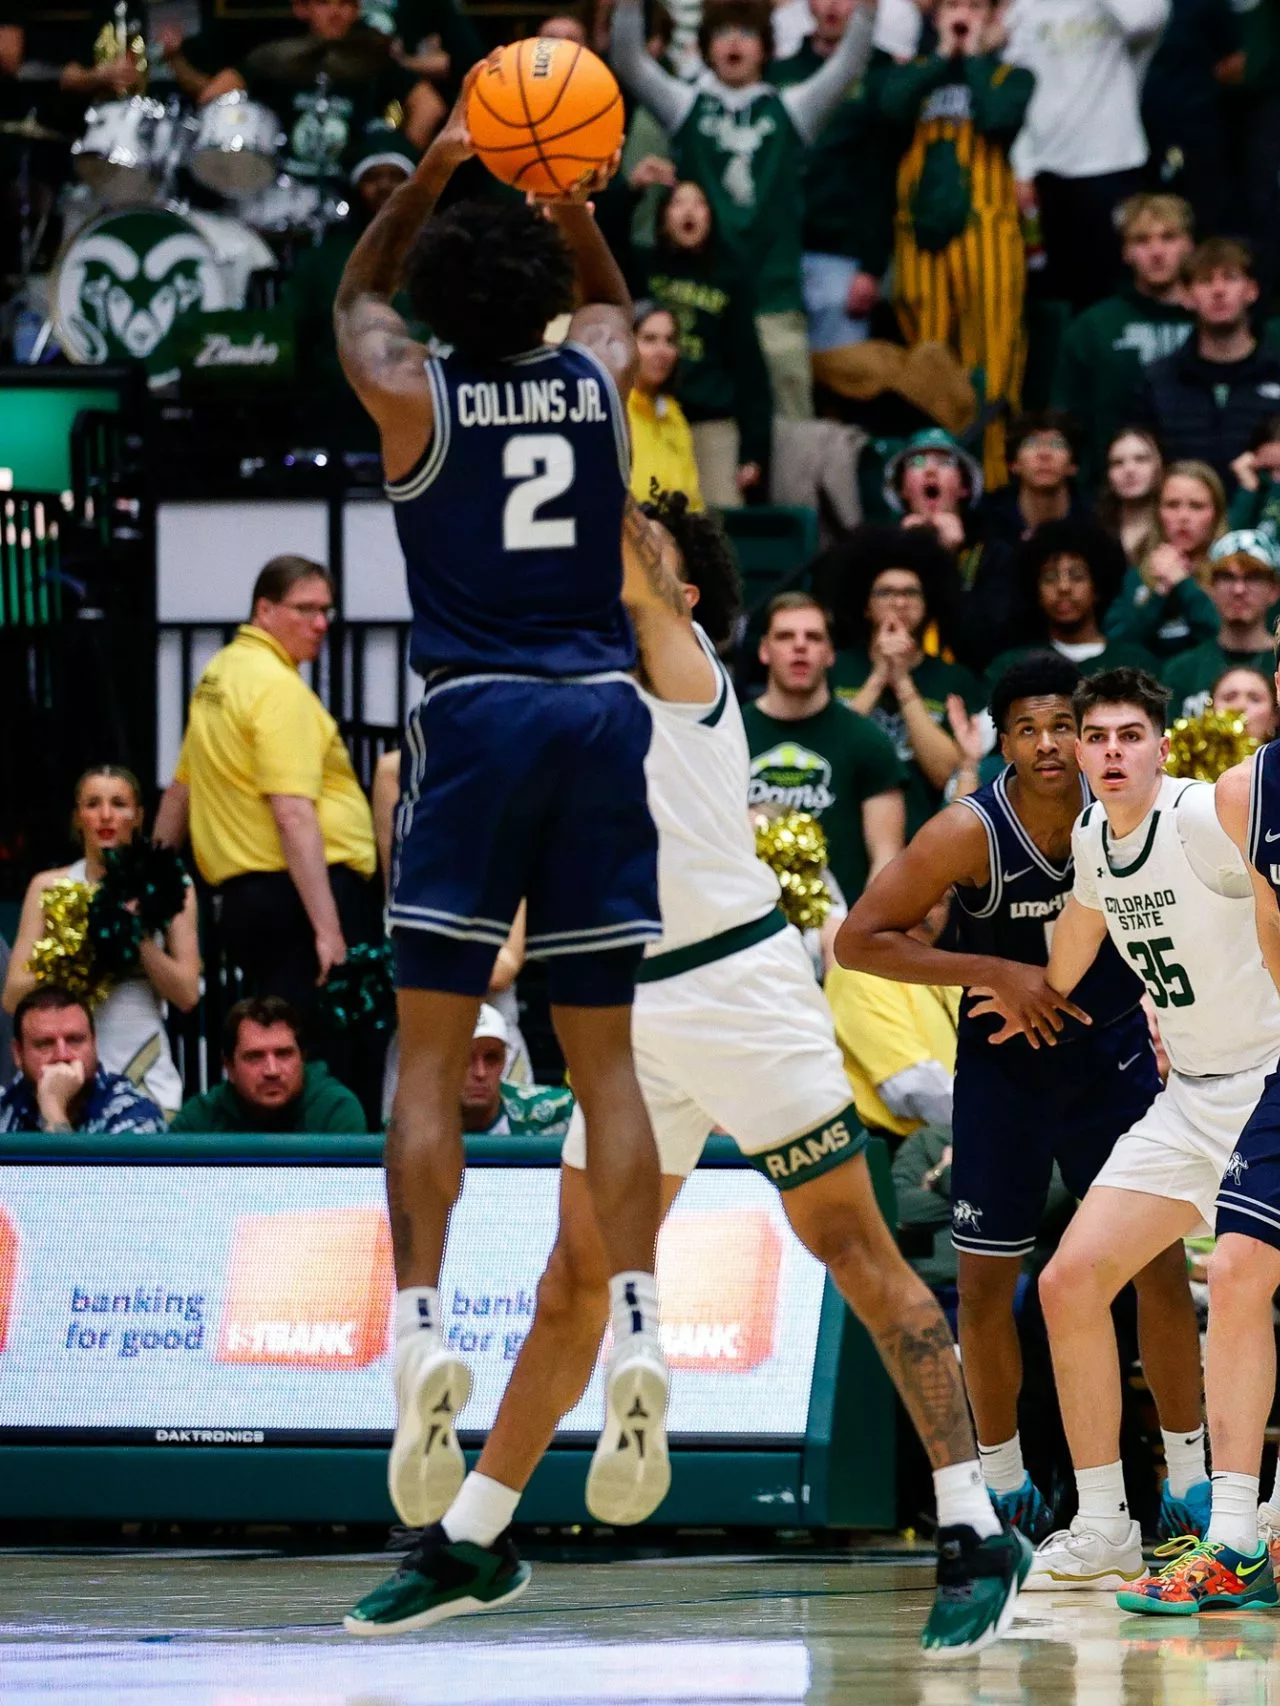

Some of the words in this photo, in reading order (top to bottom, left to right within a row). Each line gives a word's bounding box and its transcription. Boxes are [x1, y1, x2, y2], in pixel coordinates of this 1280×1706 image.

[457, 378, 567, 428] COLLINS
[569, 377, 607, 423] JR.
[503, 432, 577, 551] 2
[1010, 893, 1064, 920] UTAH
[1118, 910, 1164, 931] STATE
[1126, 936, 1196, 1009] 35
[765, 1120, 851, 1179] RAMS
[71, 1287, 205, 1321] banking
[452, 1288, 534, 1316] bank
[65, 1321, 112, 1350] for
[118, 1325, 205, 1358] good
[155, 1429, 264, 1443] DAKTRONICS
